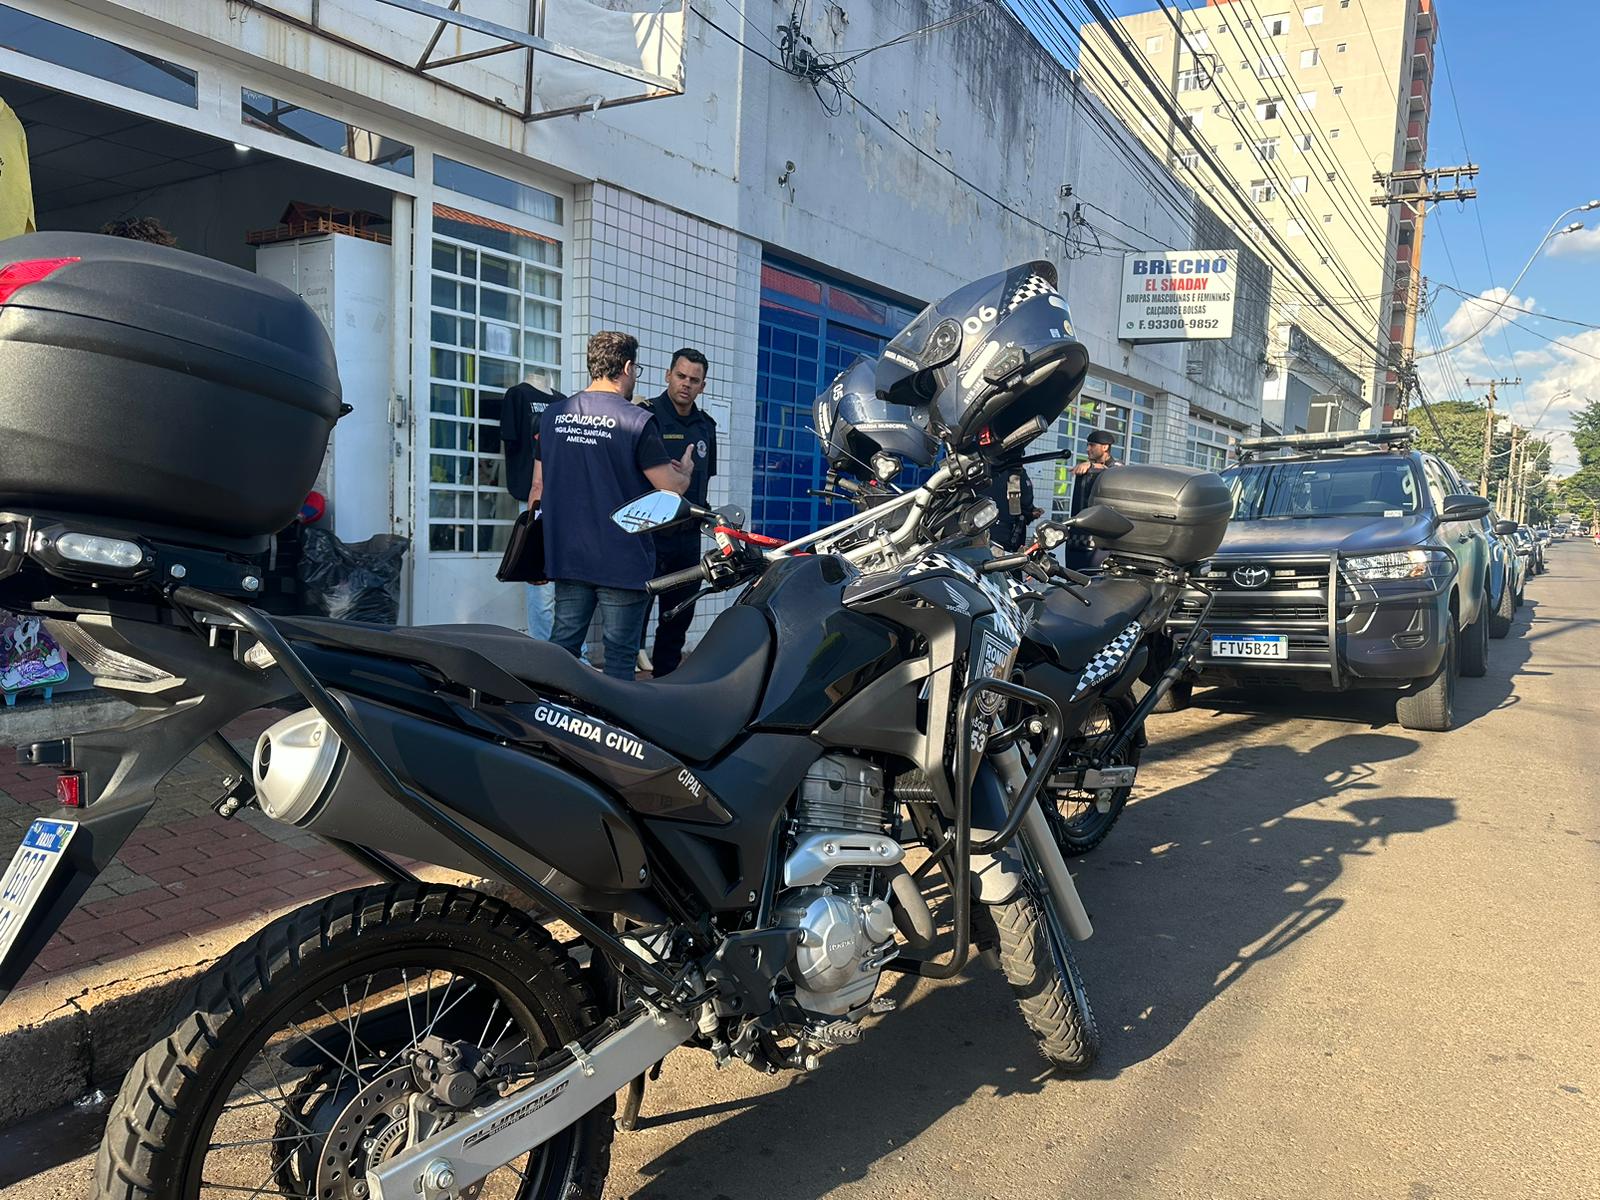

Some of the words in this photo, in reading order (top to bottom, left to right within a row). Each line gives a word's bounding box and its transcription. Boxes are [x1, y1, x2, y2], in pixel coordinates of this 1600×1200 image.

[1145, 279, 1157, 291] EL
[1161, 278, 1209, 291] SHADAY
[1126, 294, 1151, 303] ROUPAS
[1152, 293, 1190, 302] MASCULINAS
[1197, 293, 1230, 301] FEMININAS
[1146, 306, 1178, 317] CALÇADOS
[1182, 305, 1206, 314] BOLSAS
[963, 305, 998, 335] 06
[833, 383, 844, 401] 05
[555, 414, 616, 428] FISCALIZAÇÃO
[583, 429, 612, 439] SANITÁRIA
[1219, 641, 1279, 656] FTV5B21
[534, 706, 601, 743] GUARDA
[605, 732, 645, 760] CIVIL
[677, 768, 701, 798] CIPAL
